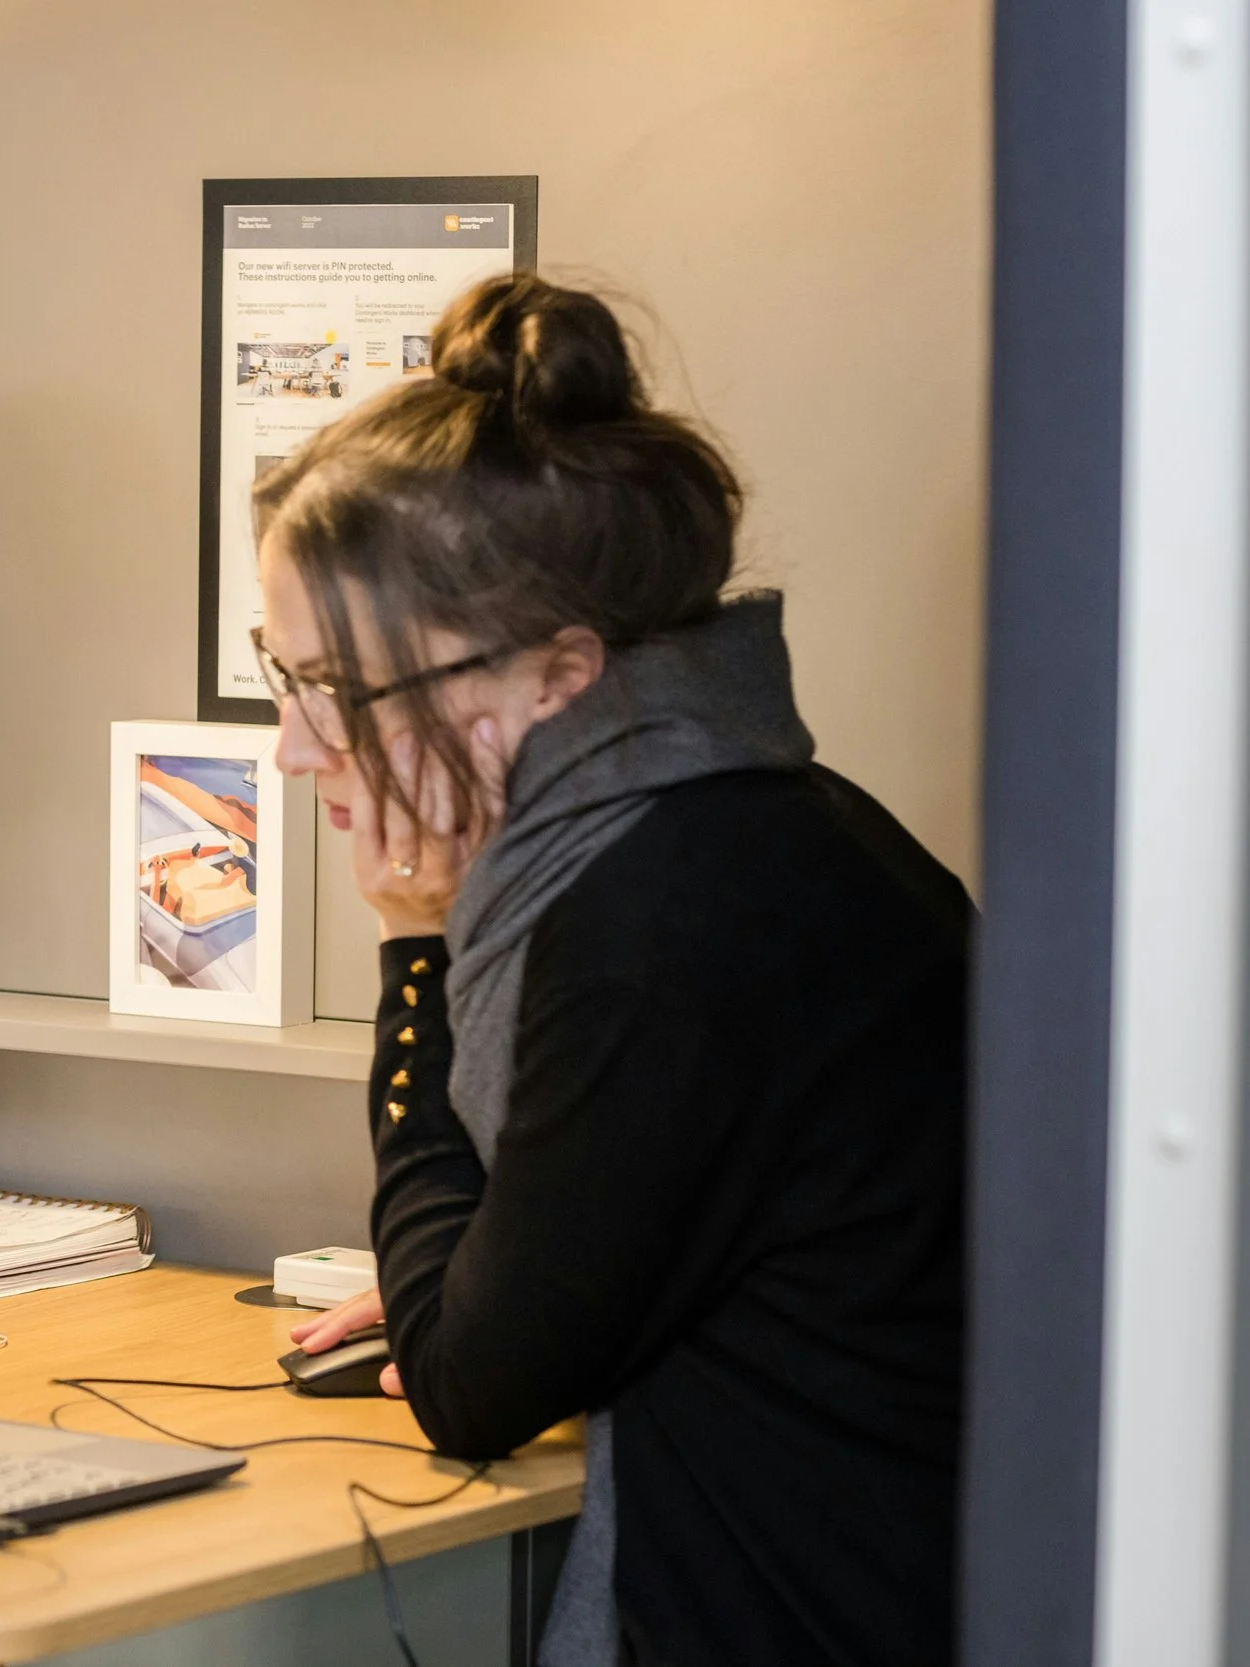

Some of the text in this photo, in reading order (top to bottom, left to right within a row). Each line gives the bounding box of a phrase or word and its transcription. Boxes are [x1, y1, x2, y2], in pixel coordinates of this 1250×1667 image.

[238, 261, 394, 273] Our new wifi server is PIN protected.
[238, 272, 438, 284] These instructions guide you to getting online.
[233, 674, 258, 684] Work.
